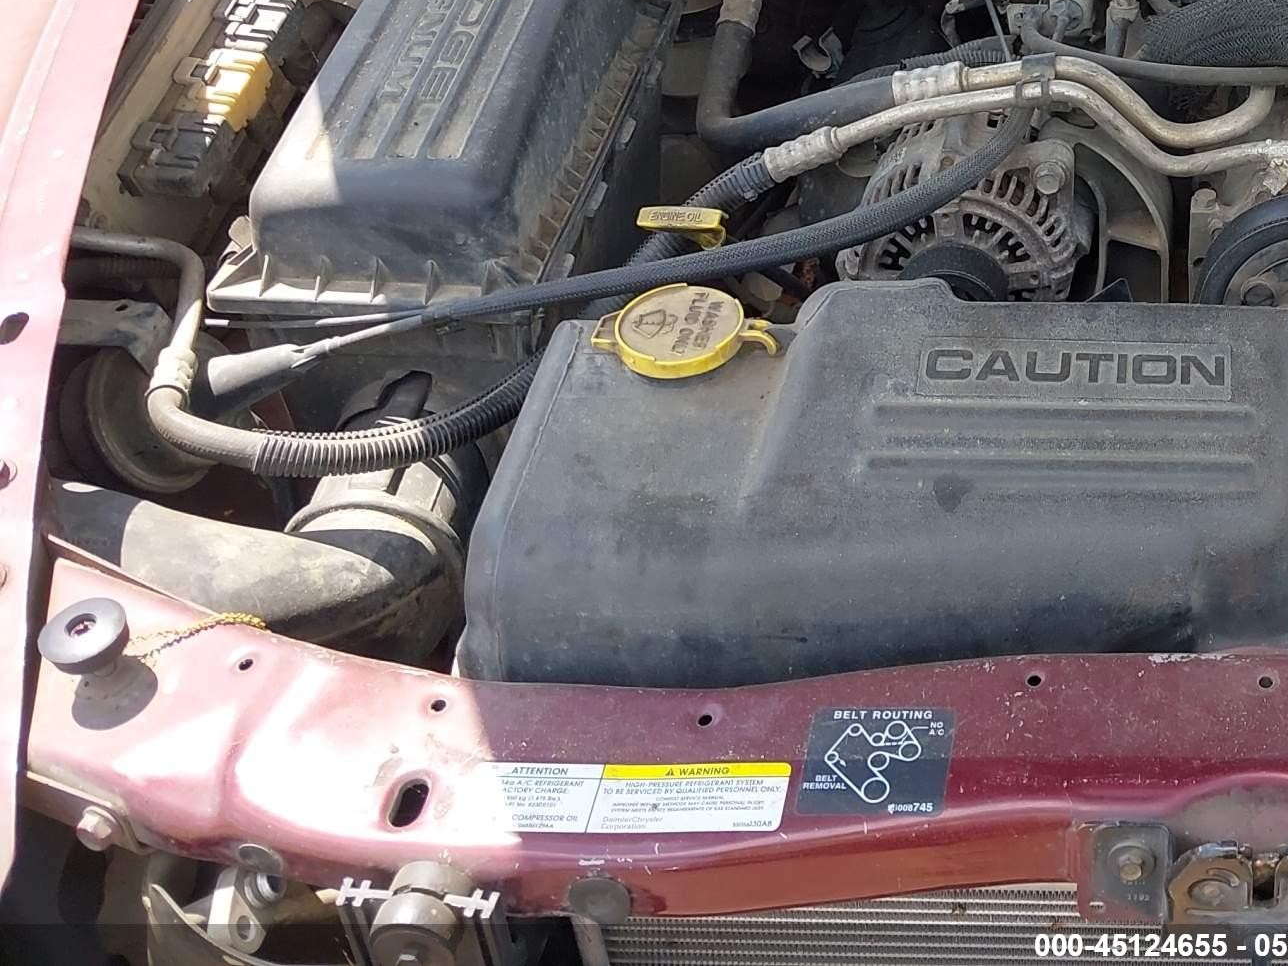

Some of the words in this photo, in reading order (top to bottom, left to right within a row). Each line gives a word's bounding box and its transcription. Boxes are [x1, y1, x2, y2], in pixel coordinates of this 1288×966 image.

[649, 210, 685, 222] ENGINE
[687, 211, 703, 223] OIL
[924, 347, 1228, 387] CAUTION
[833, 710, 868, 720] BELT
[872, 710, 933, 720] ROUTING
[929, 721, 944, 729] NO
[511, 766, 569, 776] ATTENTION
[678, 767, 730, 776] WARNING
[814, 774, 838, 782] BELT
[534, 779, 584, 787] REFRIGERANT
[625, 780, 683, 788] HIGH-PRESSURE
[802, 782, 847, 790] REMOVAL
[716, 786, 760, 794] PERSONNEL
[511, 814, 565, 822] COMPRESSOR
[602, 816, 663, 824] DaimlerChrysler
[600, 823, 646, 831] Corporation
